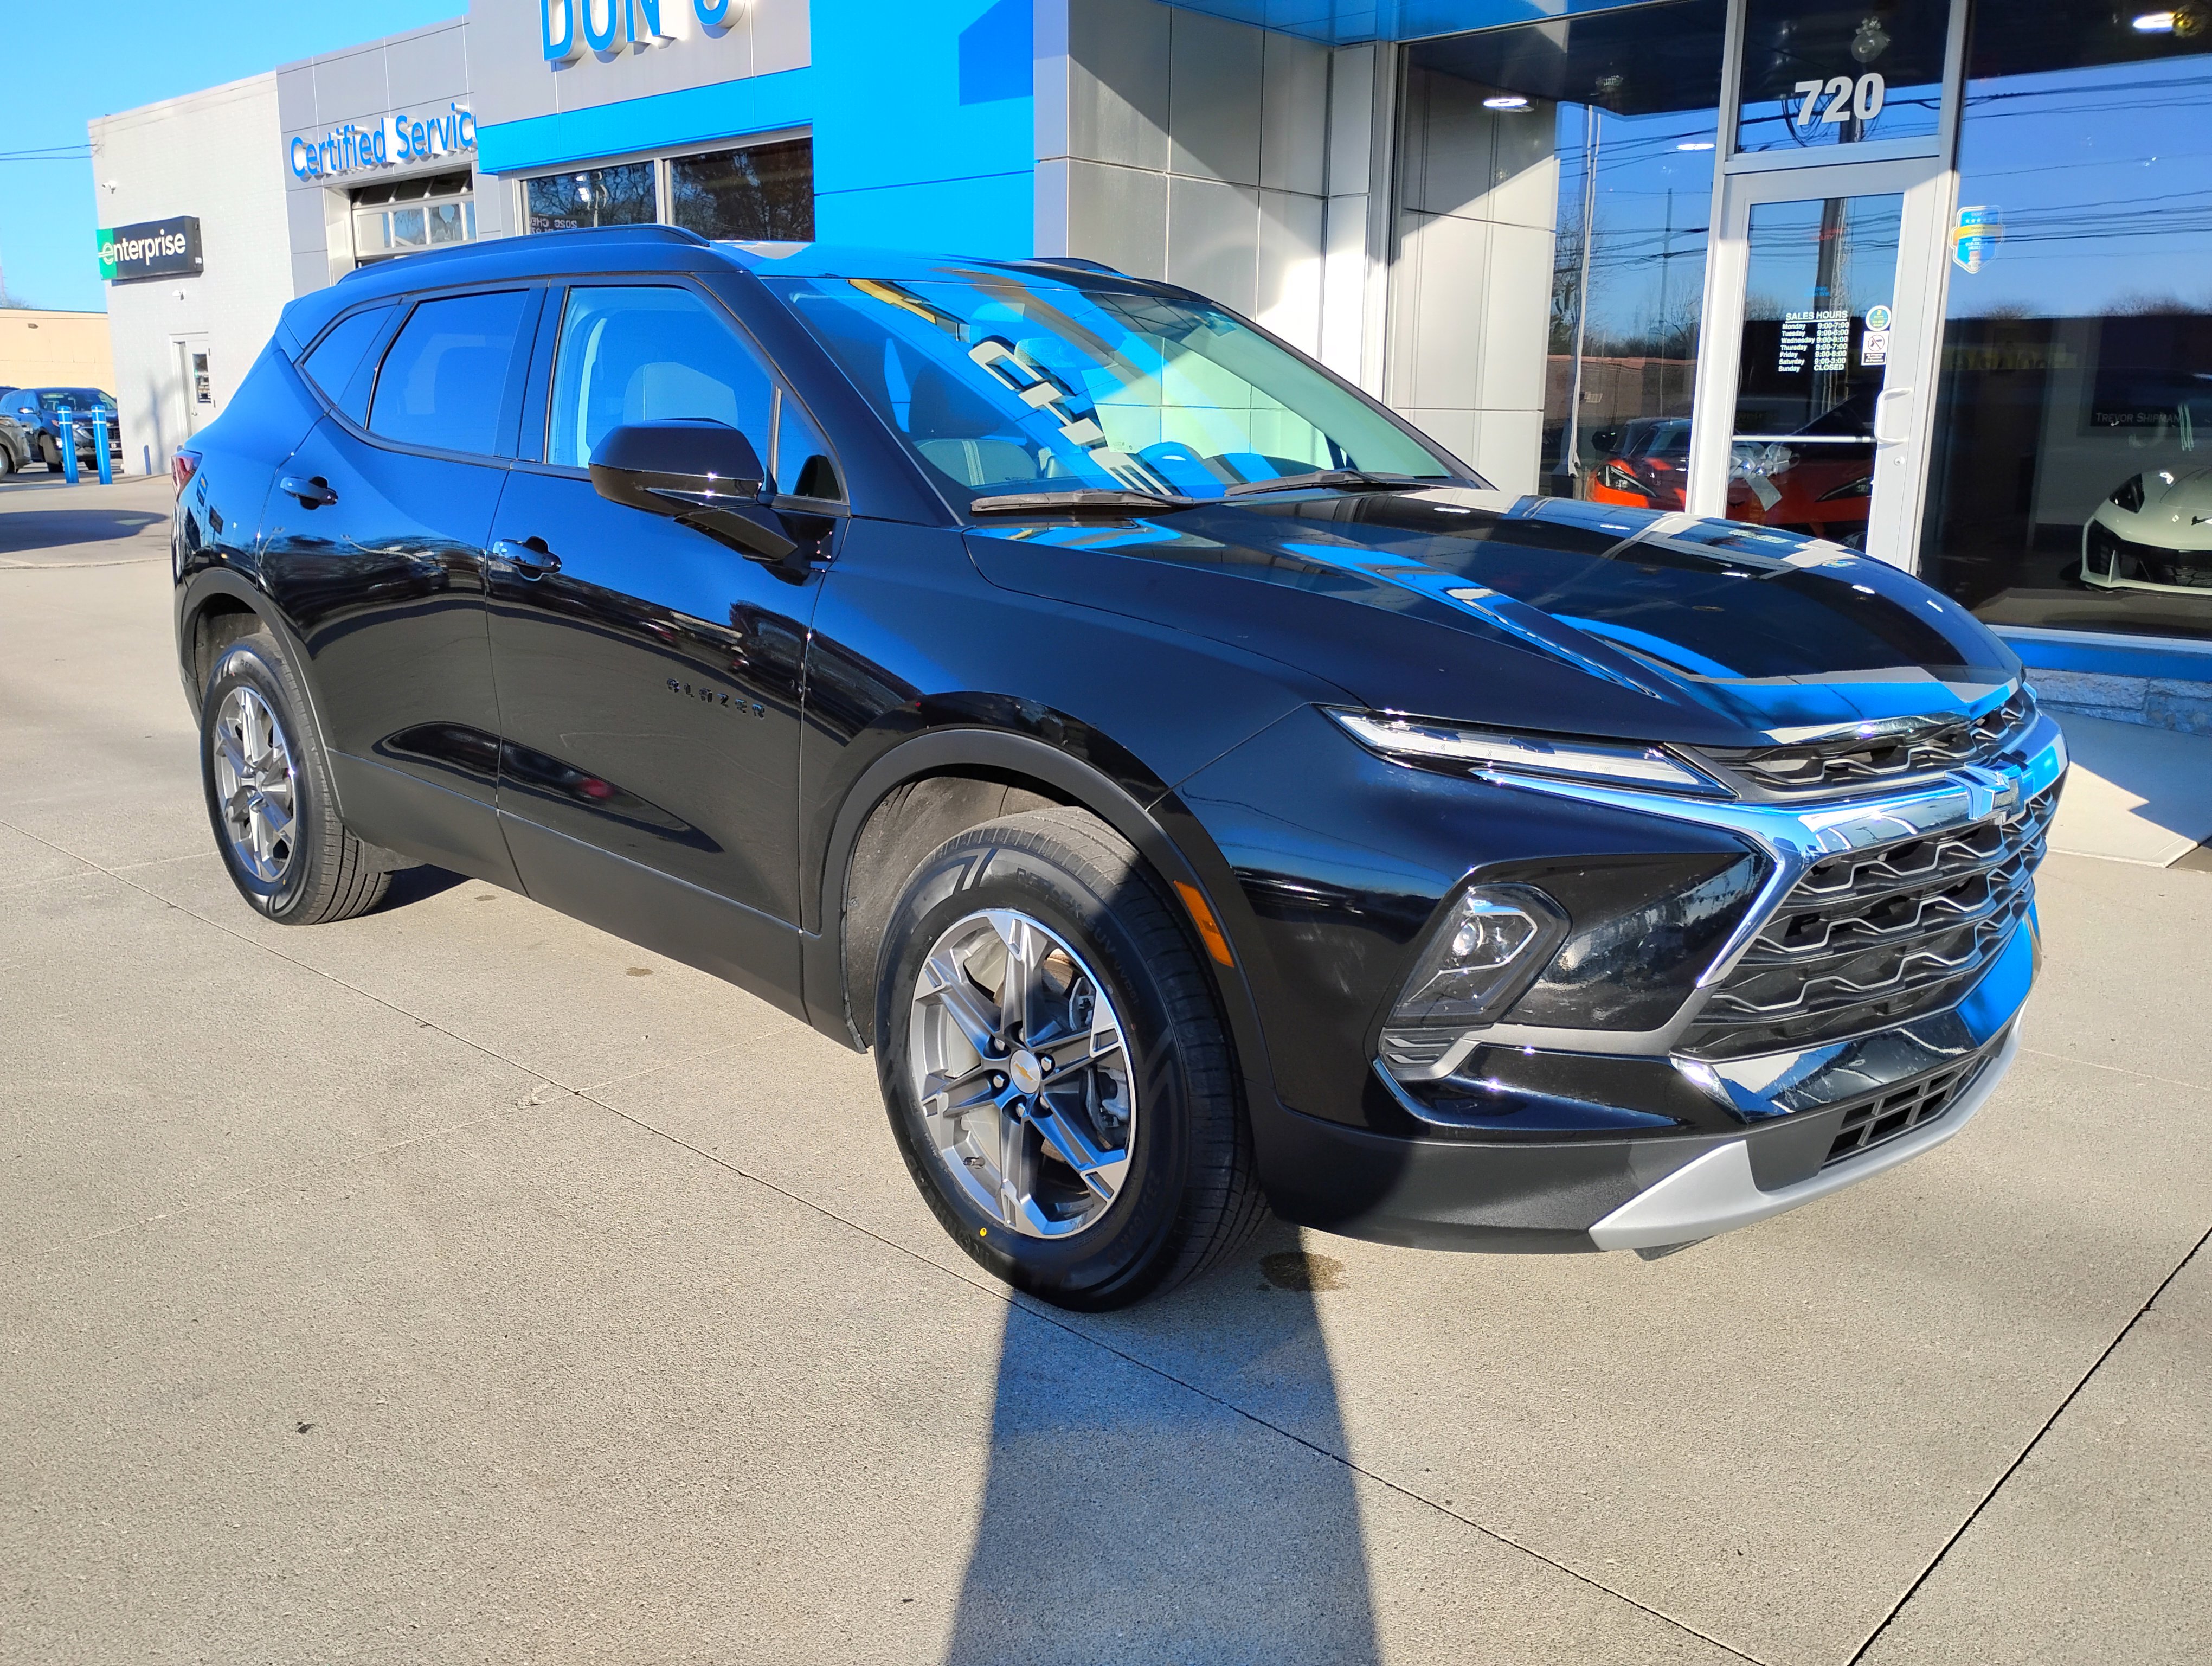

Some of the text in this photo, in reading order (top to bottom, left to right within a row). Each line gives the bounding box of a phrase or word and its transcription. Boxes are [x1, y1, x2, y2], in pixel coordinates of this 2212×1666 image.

[1795, 73, 1885, 126] 720
[291, 117, 387, 177] Certified
[99, 229, 186, 266] enterprise
[1816, 311, 1848, 319] HOURS
[2095, 412, 2180, 423] TREVOR SHIPMAN
[666, 678, 765, 721] BLAZER
